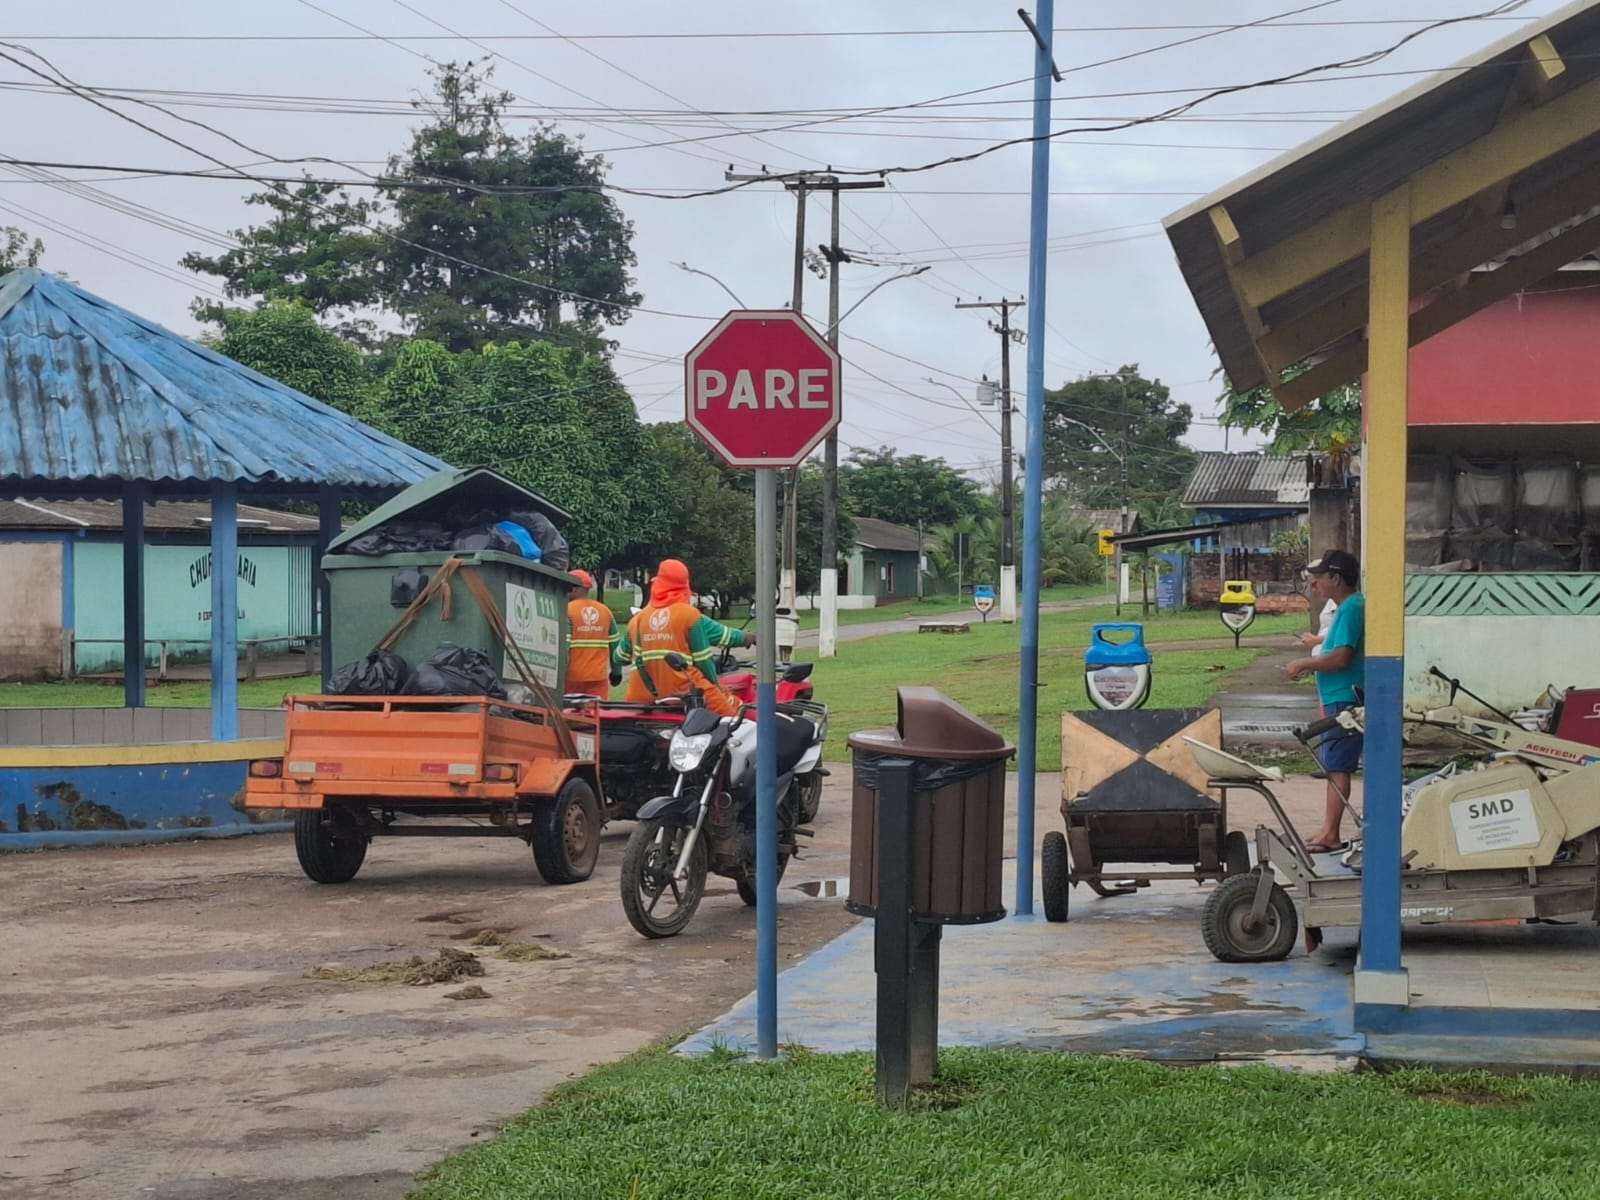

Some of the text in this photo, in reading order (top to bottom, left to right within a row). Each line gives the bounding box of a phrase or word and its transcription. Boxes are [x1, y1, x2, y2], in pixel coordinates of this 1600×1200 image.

[697, 368, 829, 410] PARE
[539, 595, 556, 617] 111
[1468, 798, 1514, 819] SMD
